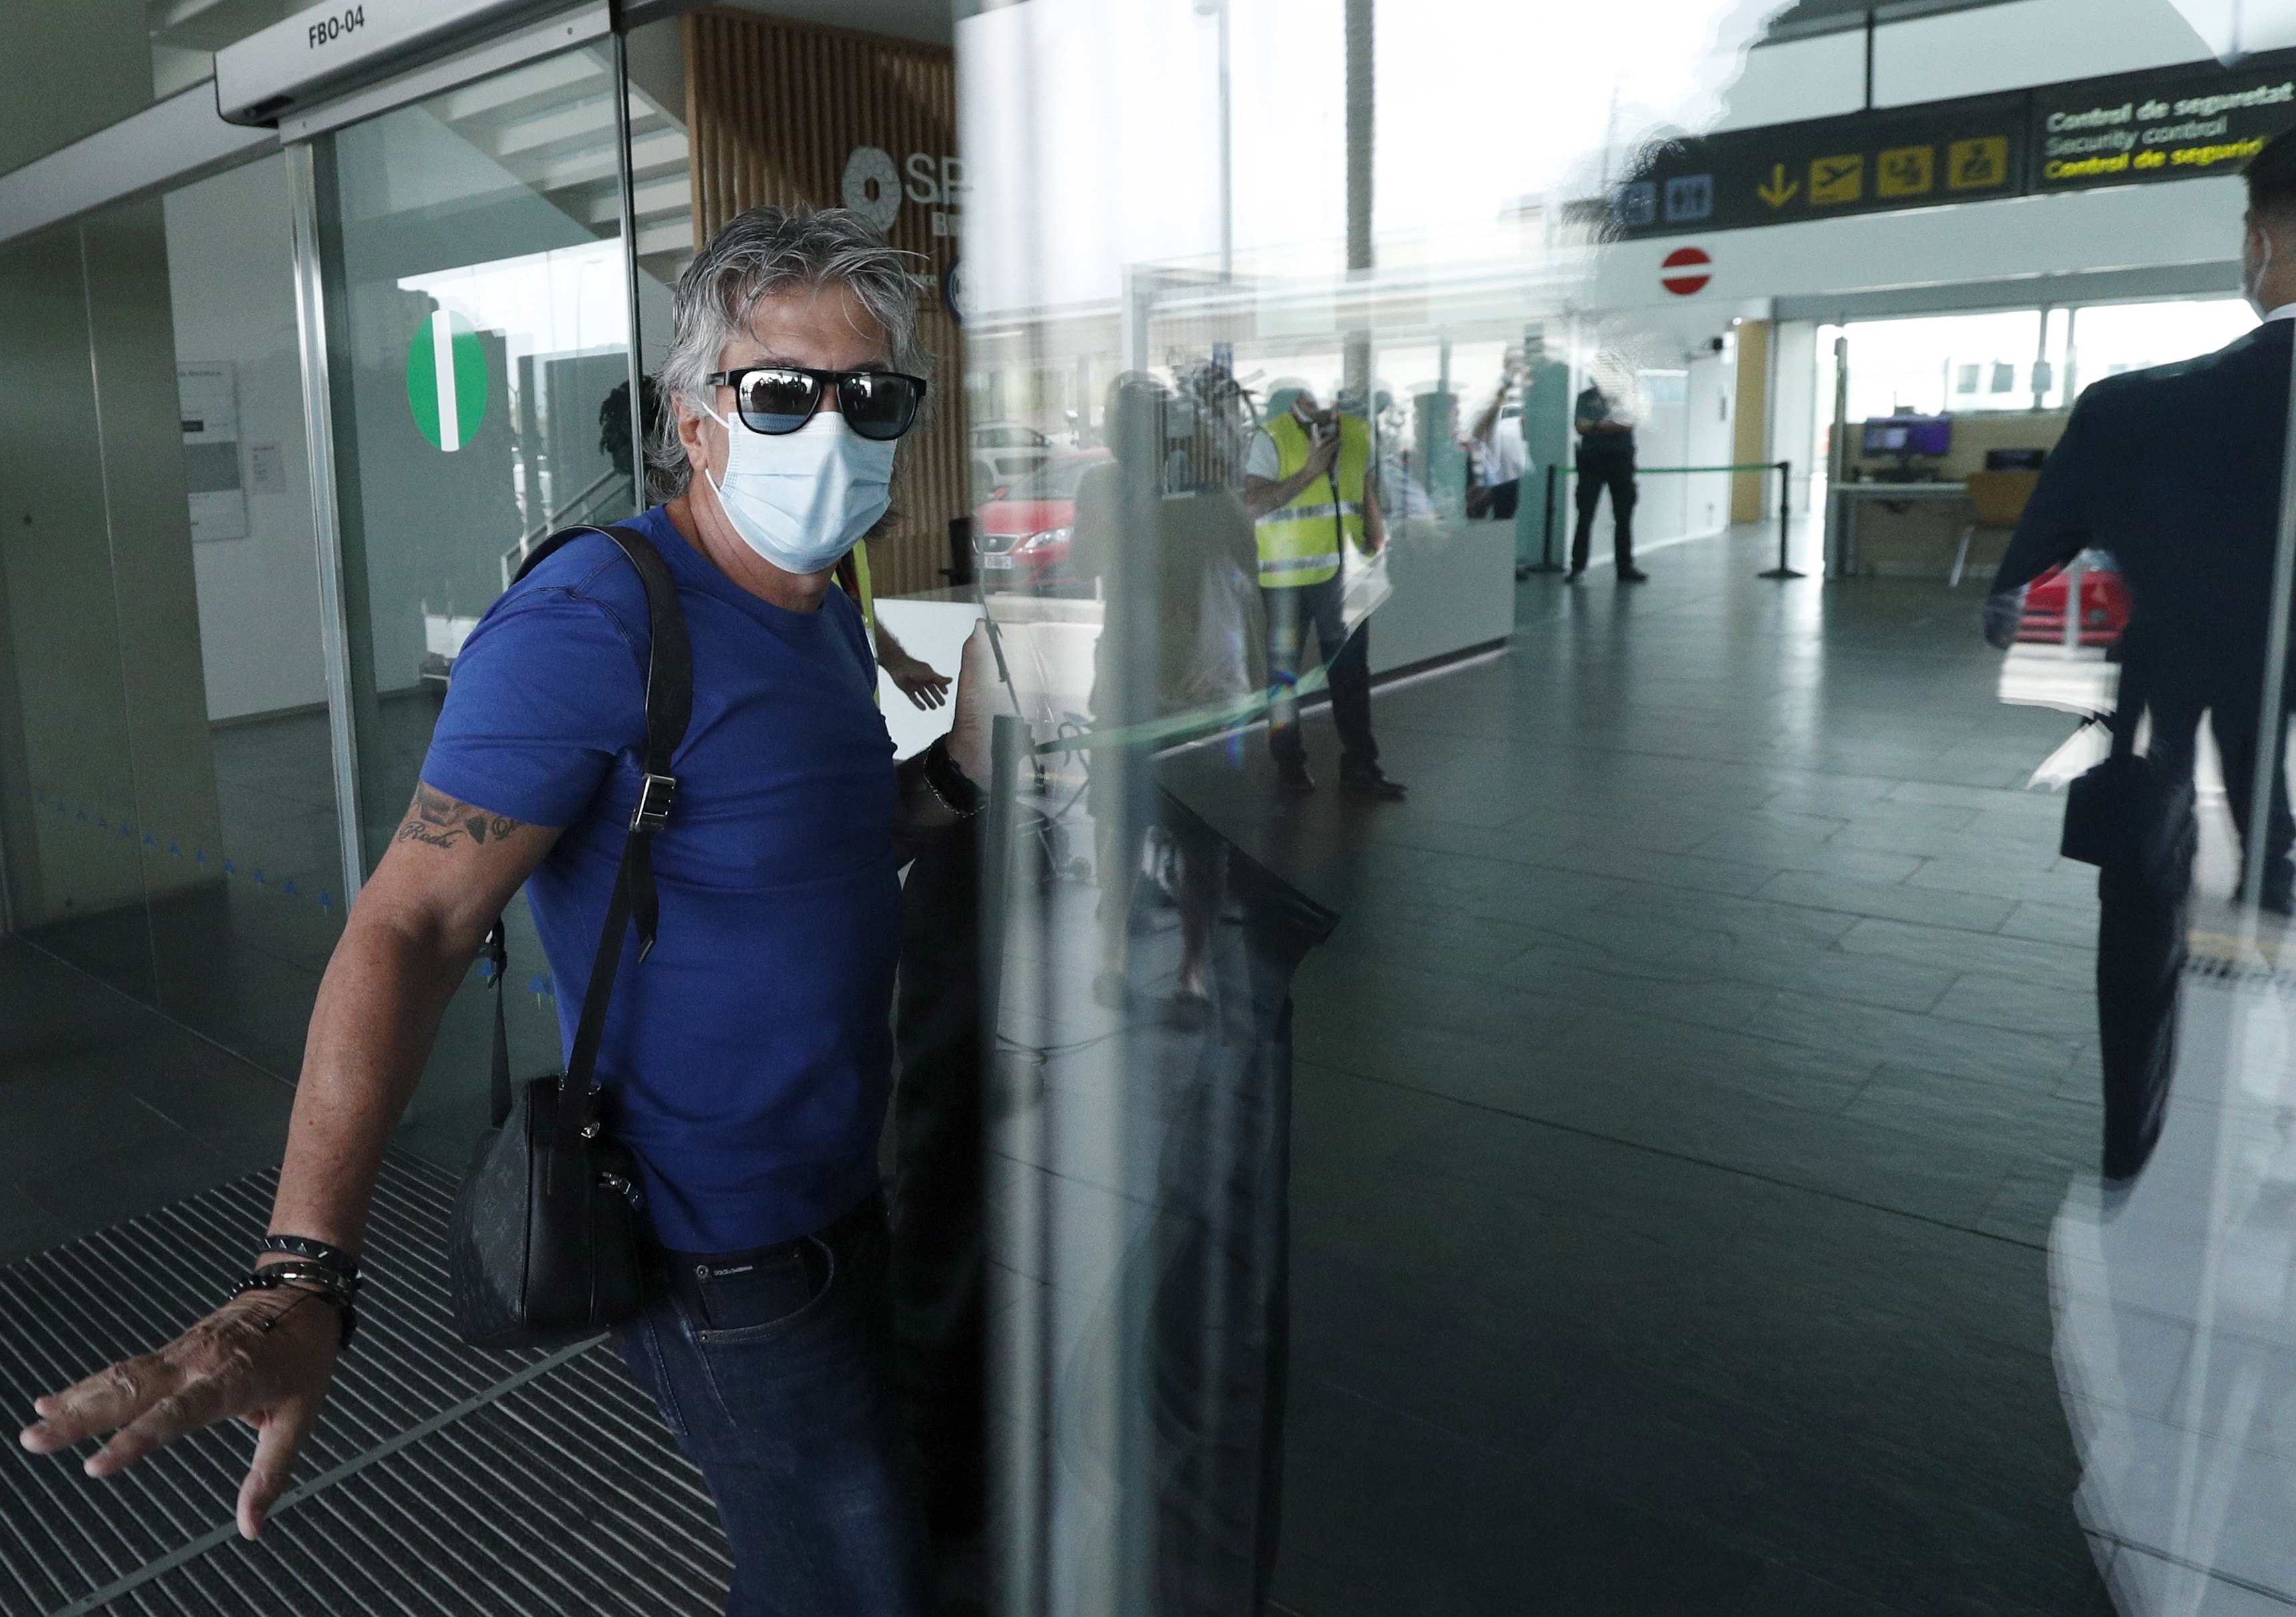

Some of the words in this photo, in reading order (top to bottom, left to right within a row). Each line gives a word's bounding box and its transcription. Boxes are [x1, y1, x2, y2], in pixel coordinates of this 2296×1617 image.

[309, 4, 365, 49] FBO-04
[2136, 99, 2171, 121] de
[2045, 130, 2138, 156] Security
[2142, 115, 2228, 144] control
[2133, 148, 2167, 169] de
